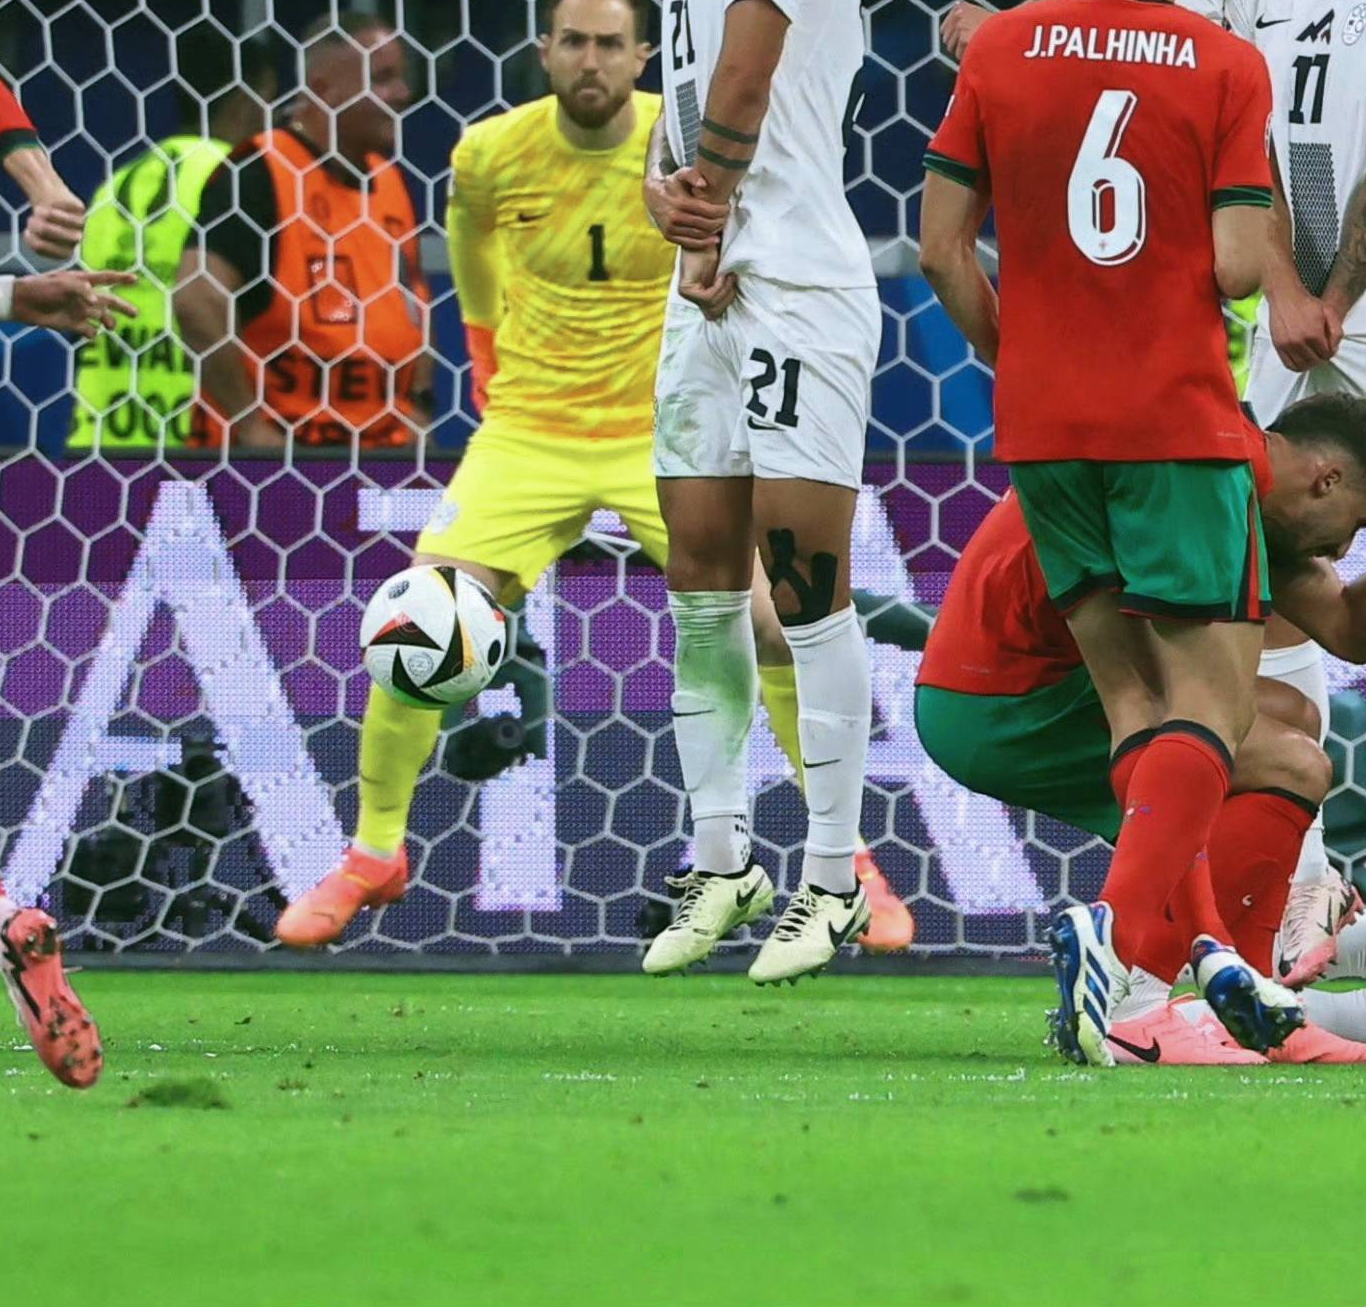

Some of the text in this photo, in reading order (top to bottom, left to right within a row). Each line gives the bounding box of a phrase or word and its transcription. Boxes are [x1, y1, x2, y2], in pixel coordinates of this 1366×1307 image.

[1023, 24, 1197, 70] J.PALHINHA
[1288, 53, 1331, 124] 17
[1067, 89, 1147, 267] 6
[587, 224, 612, 282] 1
[746, 347, 801, 428] 21
